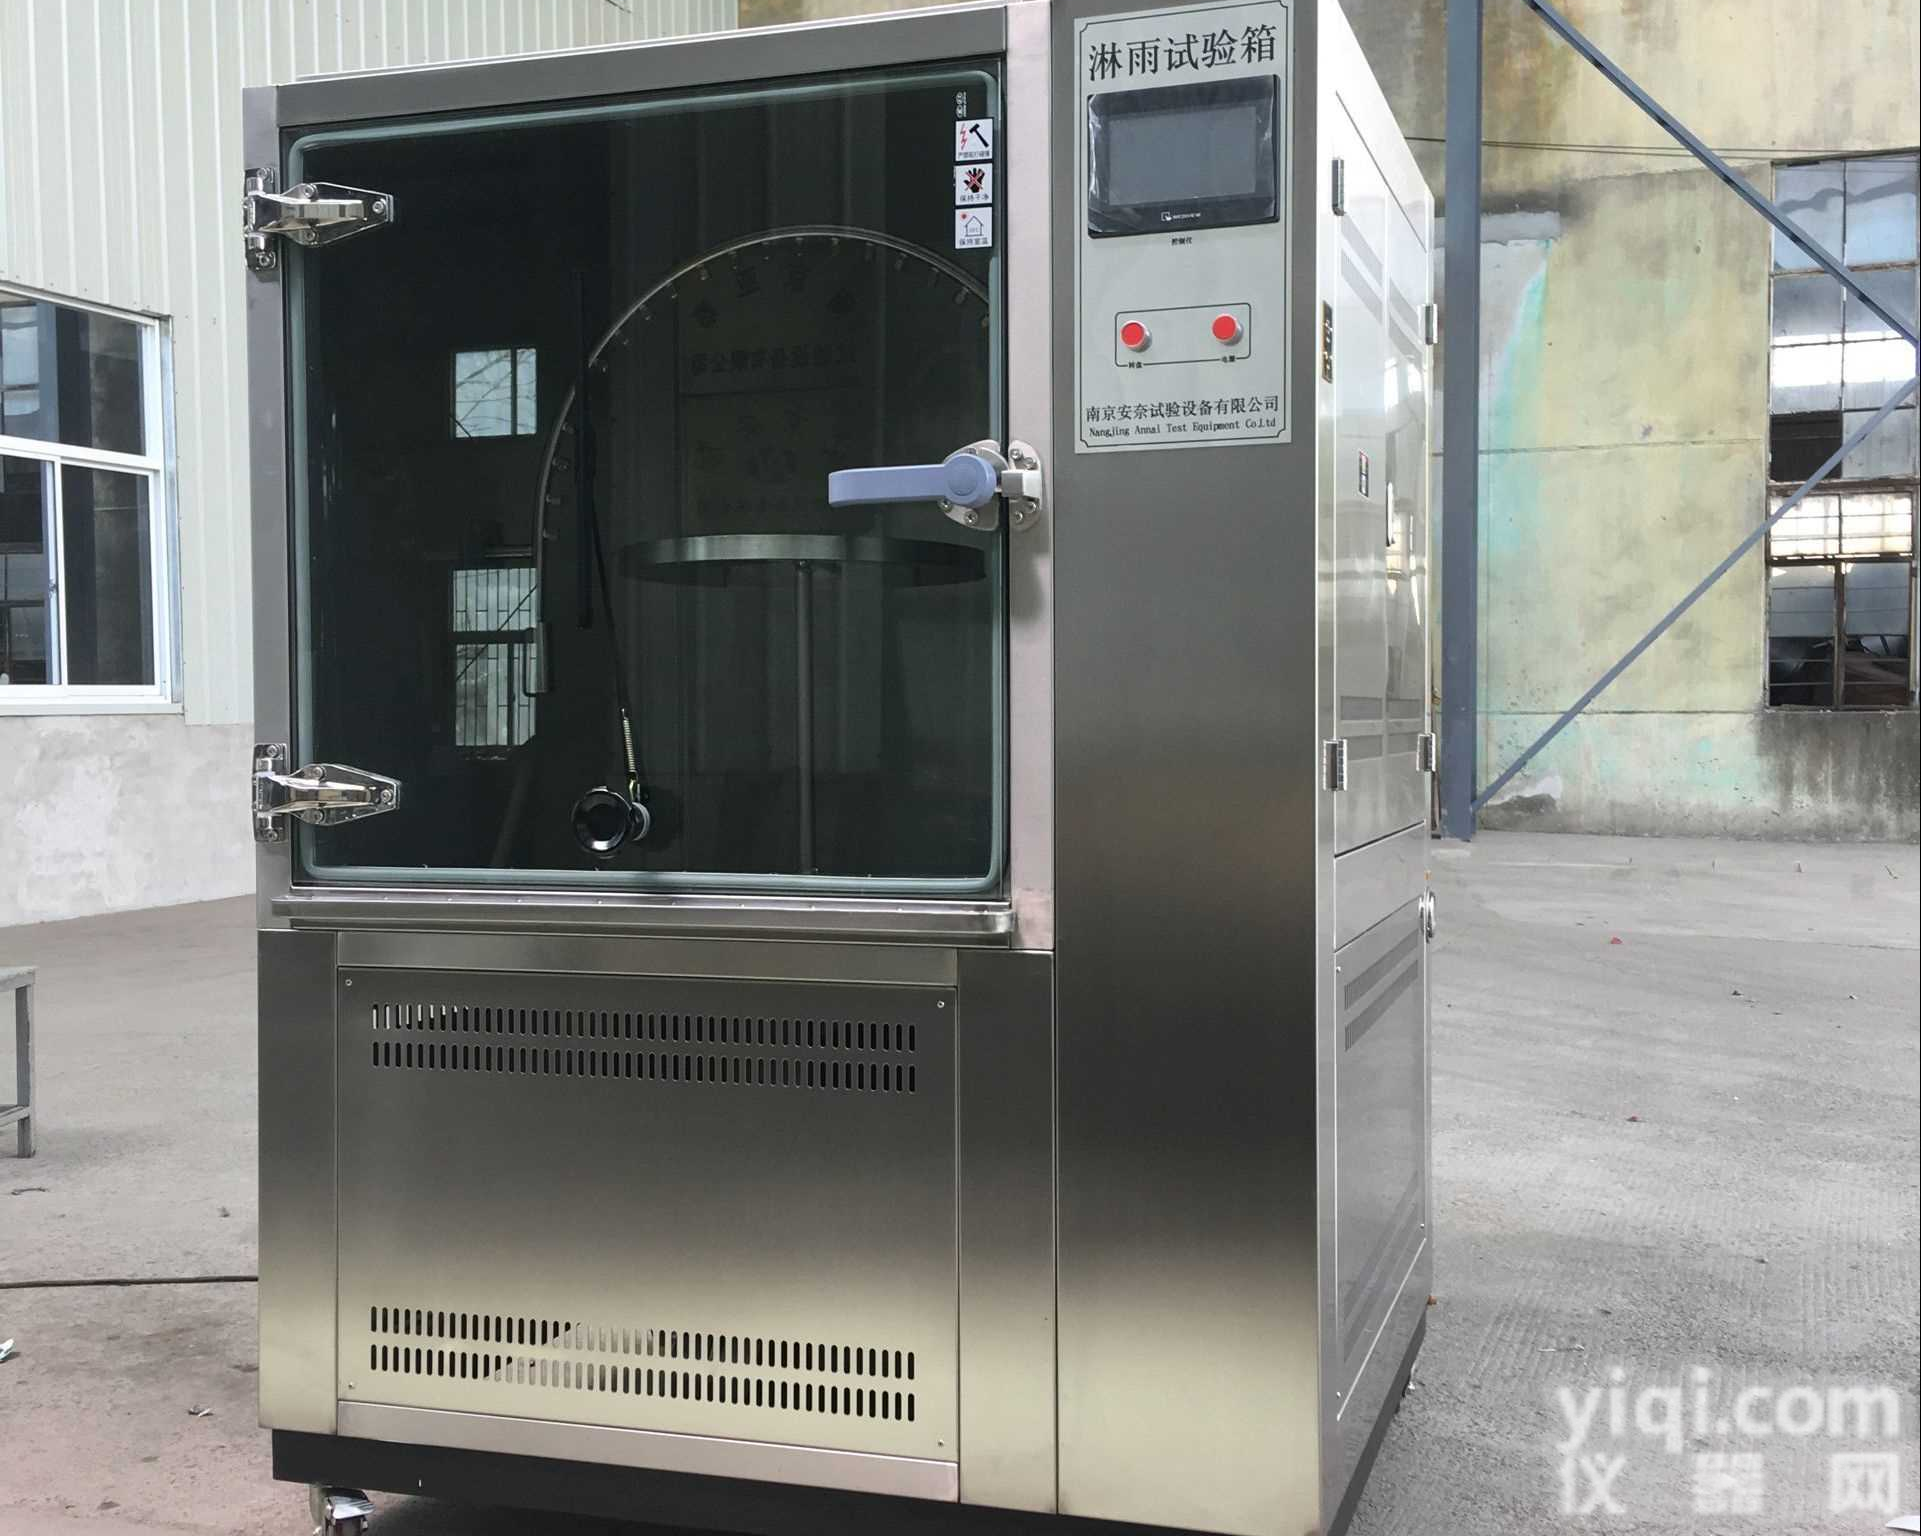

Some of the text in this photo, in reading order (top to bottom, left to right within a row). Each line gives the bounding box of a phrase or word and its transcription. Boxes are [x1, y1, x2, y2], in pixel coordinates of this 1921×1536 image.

[1088, 24, 1277, 81] 淋雨试验箱
[1086, 395, 1278, 422] 南京安奈试验设备有限公司
[1135, 424, 1160, 434] Annai
[1167, 422, 1187, 432] Test
[1192, 420, 1240, 432] Equipment
